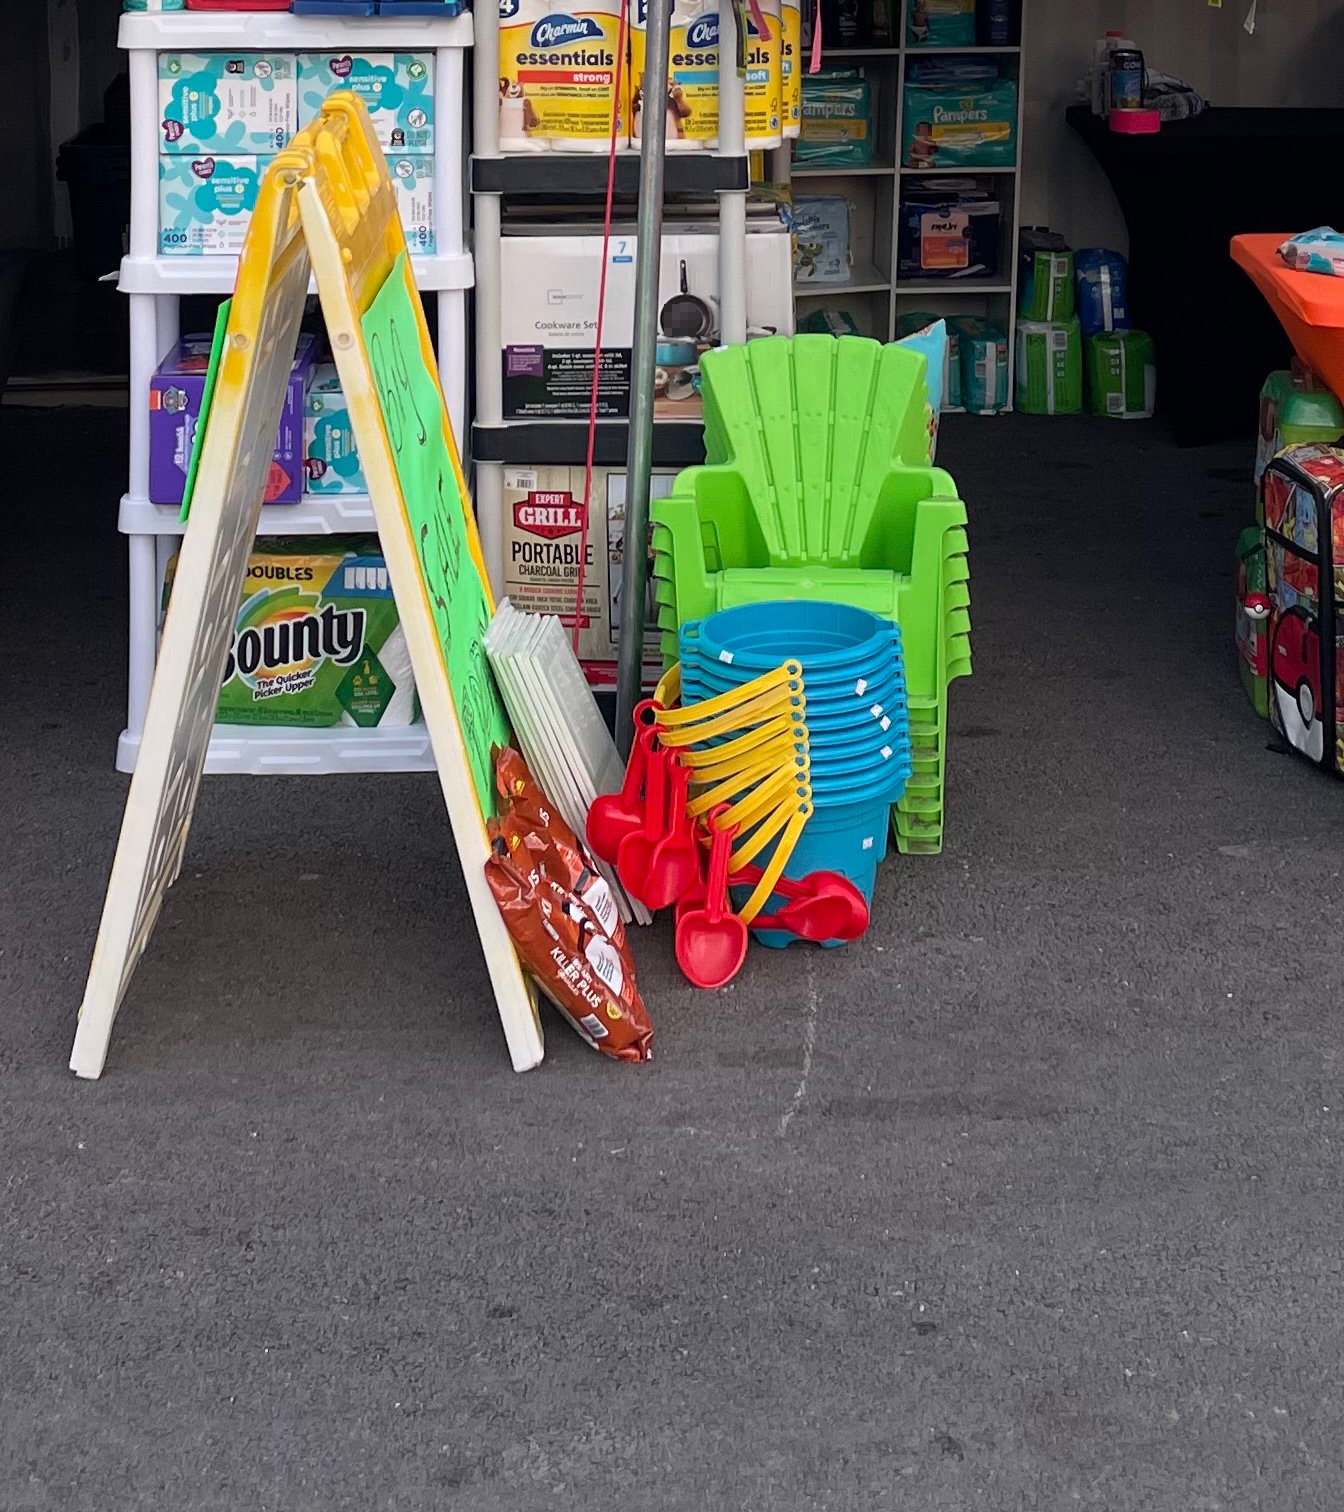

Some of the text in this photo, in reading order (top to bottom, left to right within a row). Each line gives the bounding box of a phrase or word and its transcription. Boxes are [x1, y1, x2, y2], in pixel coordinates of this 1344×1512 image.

[537, 19, 589, 43] Charmin
[516, 49, 614, 66] essentials
[672, 47, 769, 66] esseals
[349, 75, 387, 83] sensitive
[572, 73, 611, 84] strong
[352, 83, 370, 92] plus
[191, 103, 199, 122] plus
[802, 102, 856, 119] ampers
[933, 105, 988, 124] Pampers
[275, 127, 285, 149] 400
[211, 176, 250, 185] sensitive
[214, 184, 232, 194] plus
[163, 233, 188, 244] 400
[418, 225, 427, 247] 400
[619, 241, 627, 254] 7
[535, 320, 598, 330] Cookware Set
[536, 494, 564, 505] EXPERT
[518, 507, 581, 527] GRILL
[512, 541, 594, 566] PORTABLE
[519, 565, 587, 578] CHARCOAL GRI
[257, 669, 312, 689] The Quicker
[255, 677, 315, 701] Picker Upper
[548, 945, 582, 981] KILLER
[574, 979, 603, 1009] PLUS
